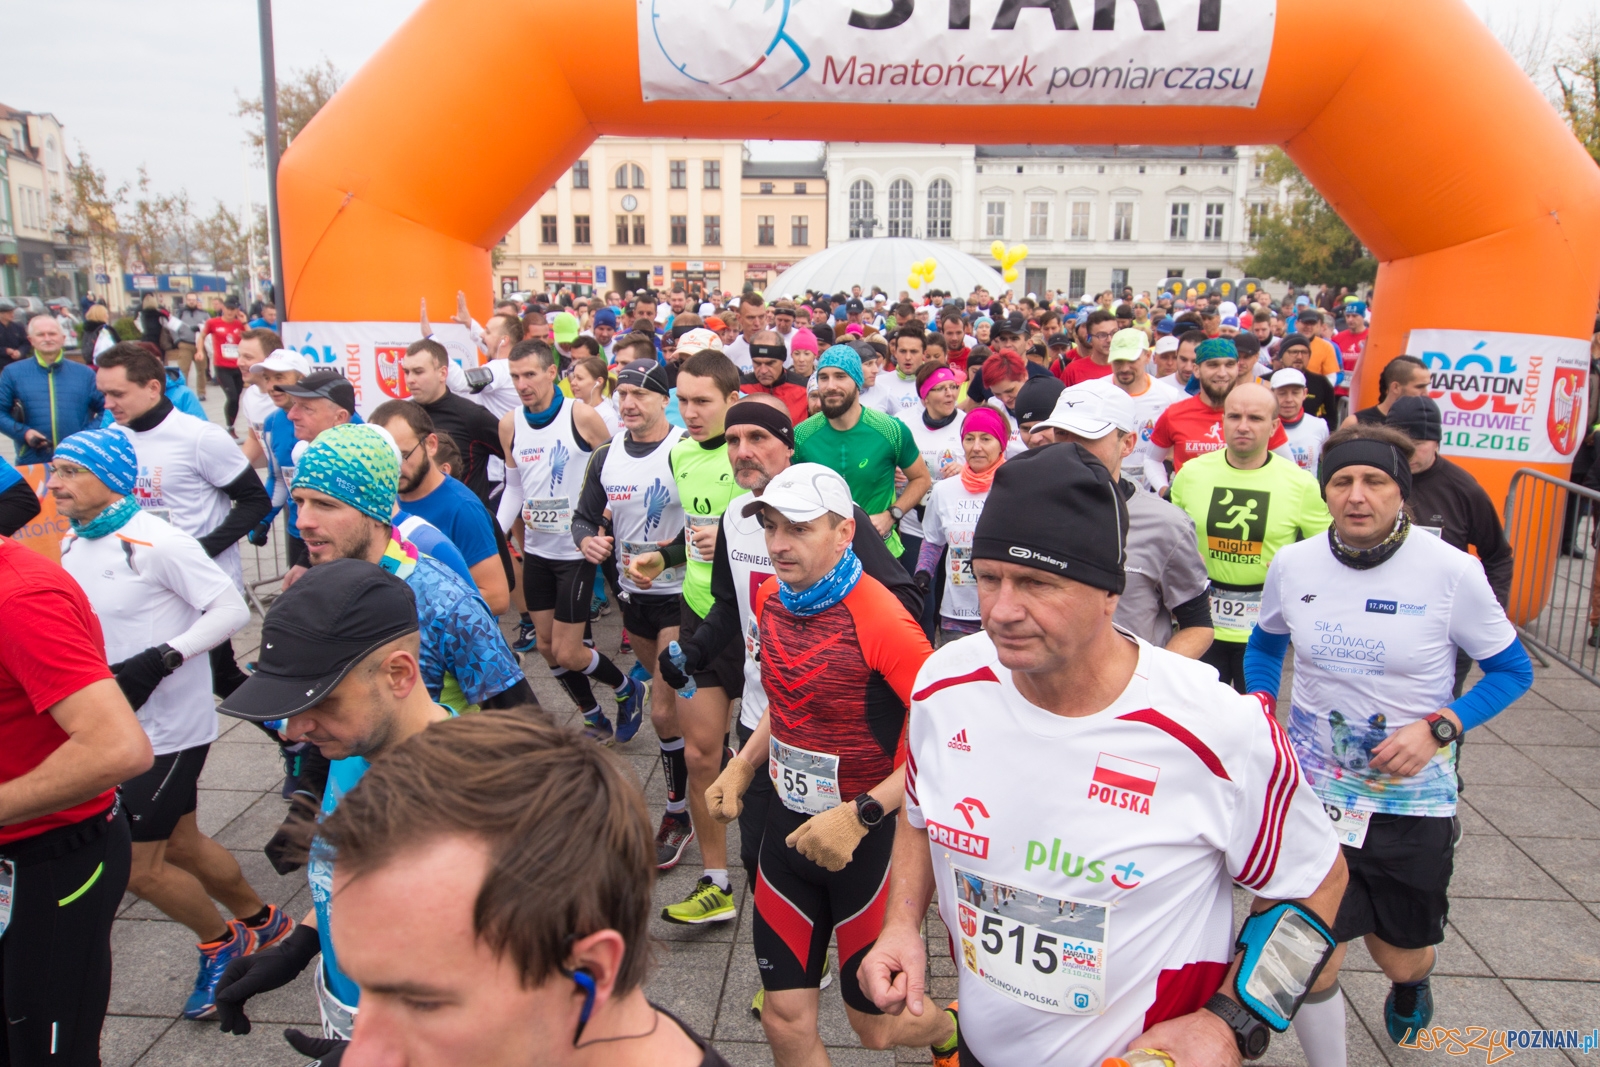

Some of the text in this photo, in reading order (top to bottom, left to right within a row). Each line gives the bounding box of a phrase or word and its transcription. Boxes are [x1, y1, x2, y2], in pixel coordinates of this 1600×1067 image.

[822, 54, 1255, 95] Maratończyk pomiarczasu
[1521, 356, 1543, 415] SKOKI
[1441, 411, 1533, 431] GROWIEC
[519, 447, 545, 456] HERNIK
[521, 455, 541, 463] TEAM
[153, 466, 163, 498] SKOKI
[605, 485, 639, 493] HERNIK
[532, 510, 558, 523] 222
[1218, 539, 1253, 554] night
[1032, 552, 1068, 569] Kalenji
[1209, 549, 1261, 564] runners
[1300, 594, 1317, 603] 4F
[1213, 599, 1245, 617] 192
[1368, 602, 1395, 611] 17. PKO
[1314, 621, 1343, 633] SIŁA
[1321, 634, 1386, 650] ODWAGA
[1311, 645, 1385, 663] SZYBKOŚĆ
[1365, 668, 1384, 676] 2016
[947, 741, 971, 752] adidas
[784, 768, 808, 796] 55
[1087, 783, 1150, 815] POLSKA
[928, 823, 985, 856] ORLEN
[1024, 837, 1107, 883] plus
[981, 915, 1058, 974] 515
[1062, 949, 1097, 962] MARATON
[1061, 967, 1102, 981] 23.10.2016
[1062, 961, 1101, 974] WĄGROWIEC
[984, 972, 1022, 996] POLINOVA
[1023, 990, 1059, 1007] POLSKA
